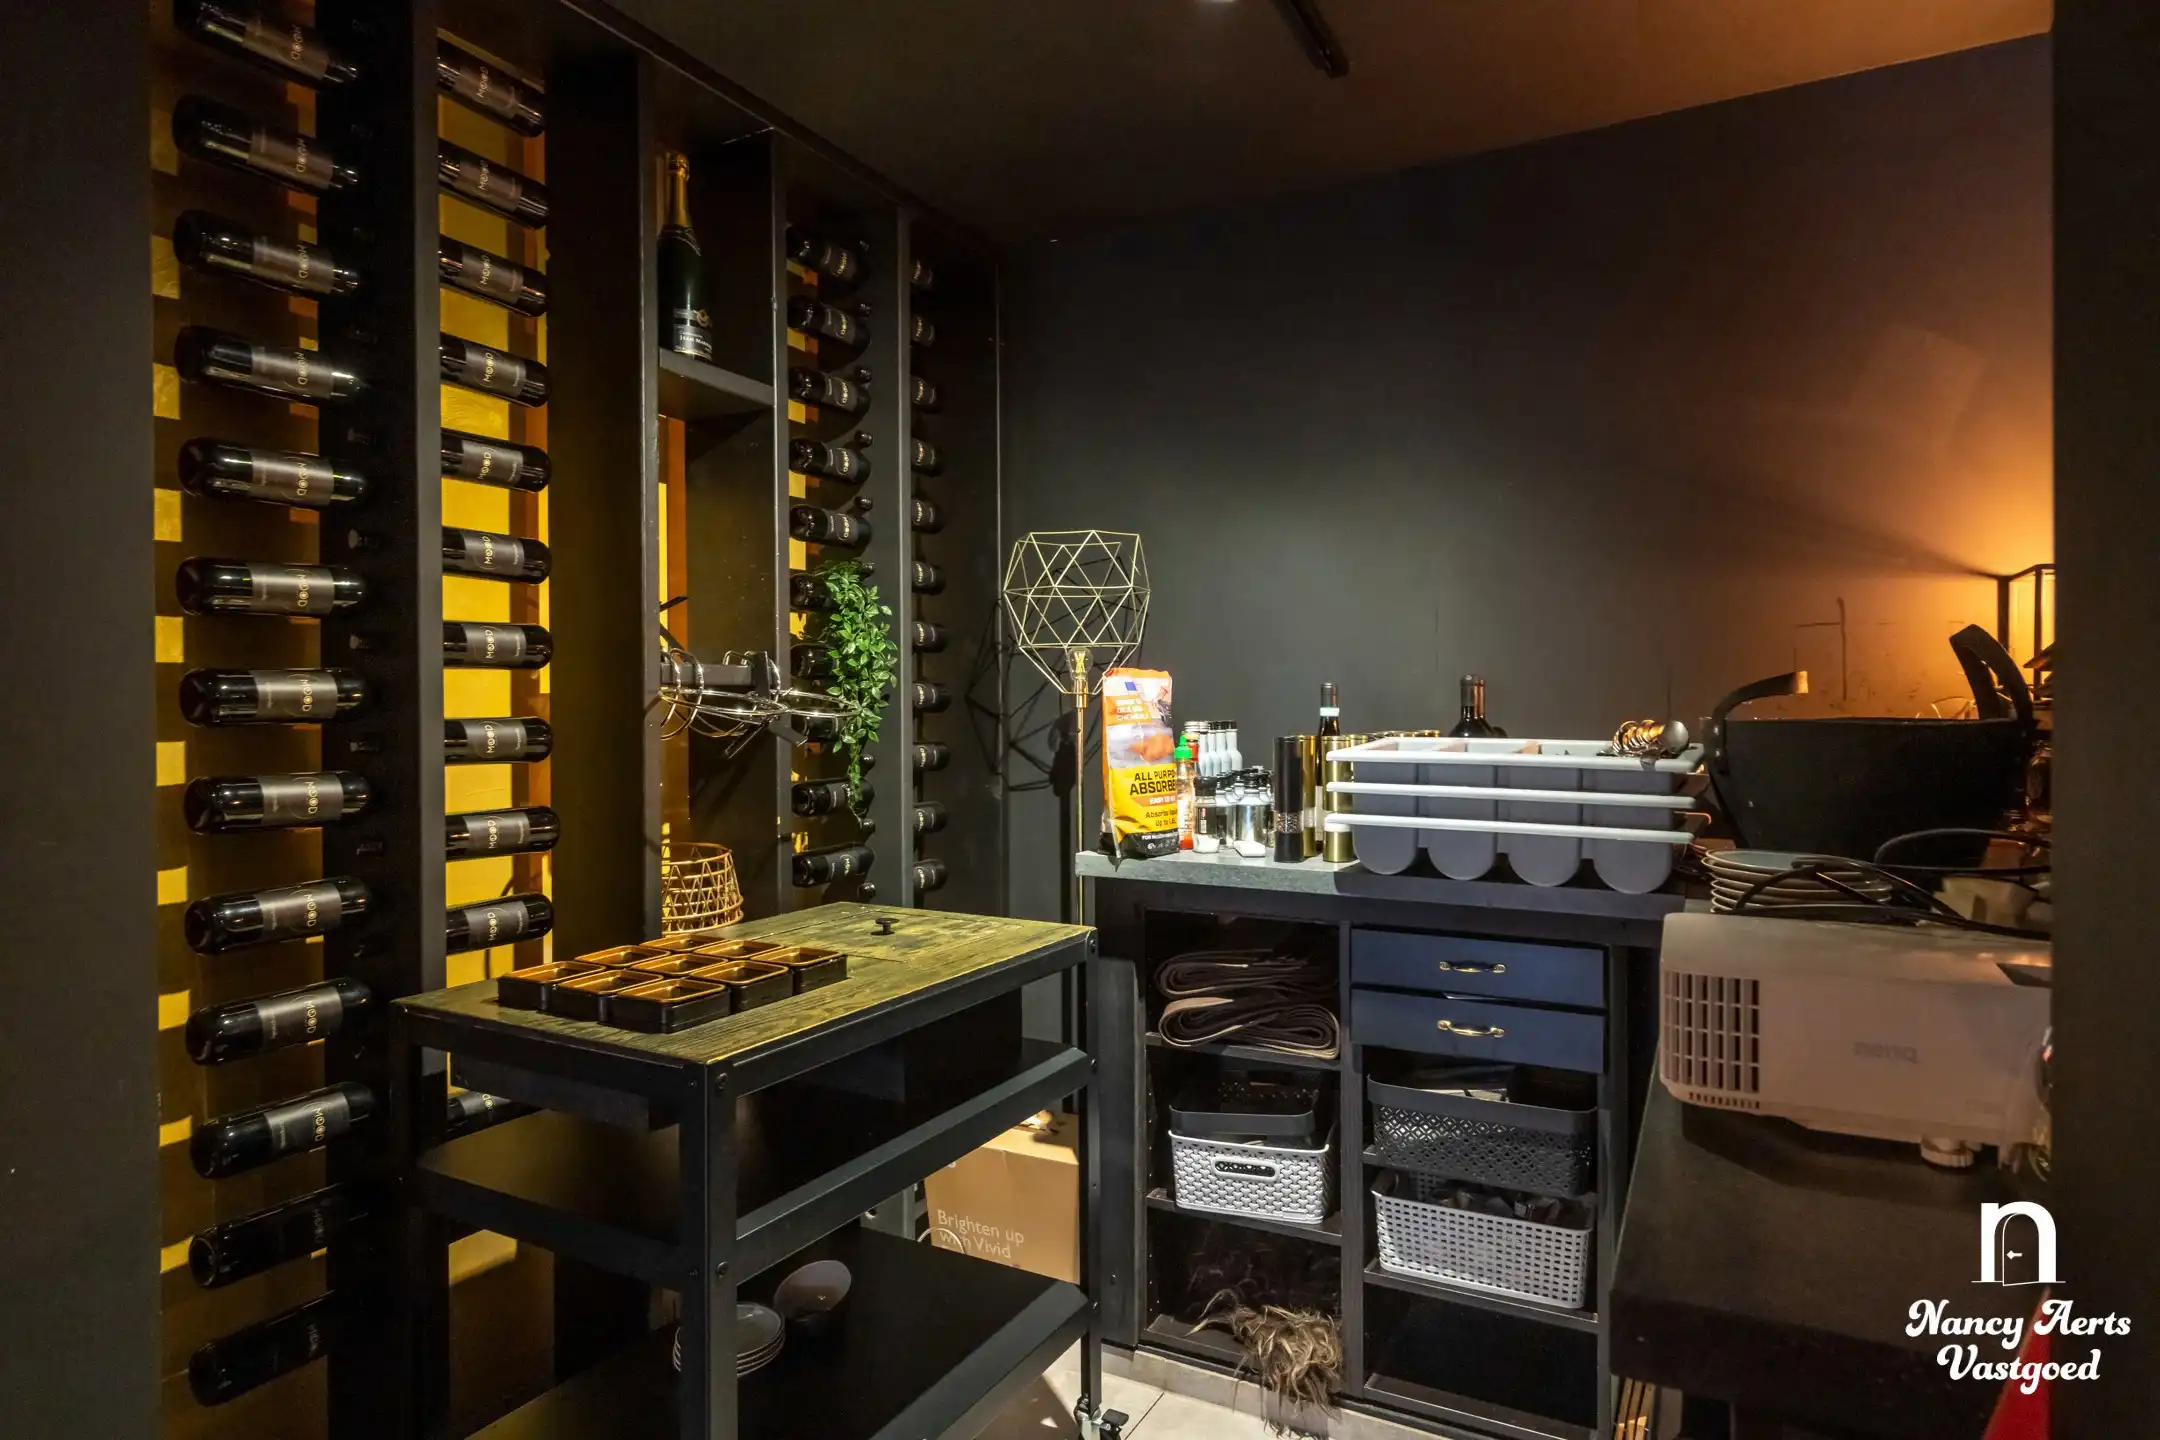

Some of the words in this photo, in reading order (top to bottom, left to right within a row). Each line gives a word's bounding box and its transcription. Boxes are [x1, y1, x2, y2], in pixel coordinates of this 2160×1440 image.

[483, 352, 493, 382] MOOD
[296, 462, 309, 497] MOOD
[478, 452, 491, 480] MOOD
[482, 535, 493, 565] MOOD
[297, 574, 309, 607] MOOD
[484, 629, 495, 659] MOOD
[300, 679, 313, 712] MOOD
[485, 724, 496, 754] MOOD
[1134, 772, 1153, 782] ALL
[305, 781, 318, 815] MOOD
[487, 819, 498, 849] MOOD
[304, 893, 317, 928] MOOD
[487, 911, 498, 941] MOOD
[304, 1000, 317, 1035] MOOD
[314, 1107, 326, 1142] MOOD
[938, 1209, 1000, 1239] Brighten
[1005, 1231, 1025, 1247] up
[973, 1235, 1012, 1259] Vivid
